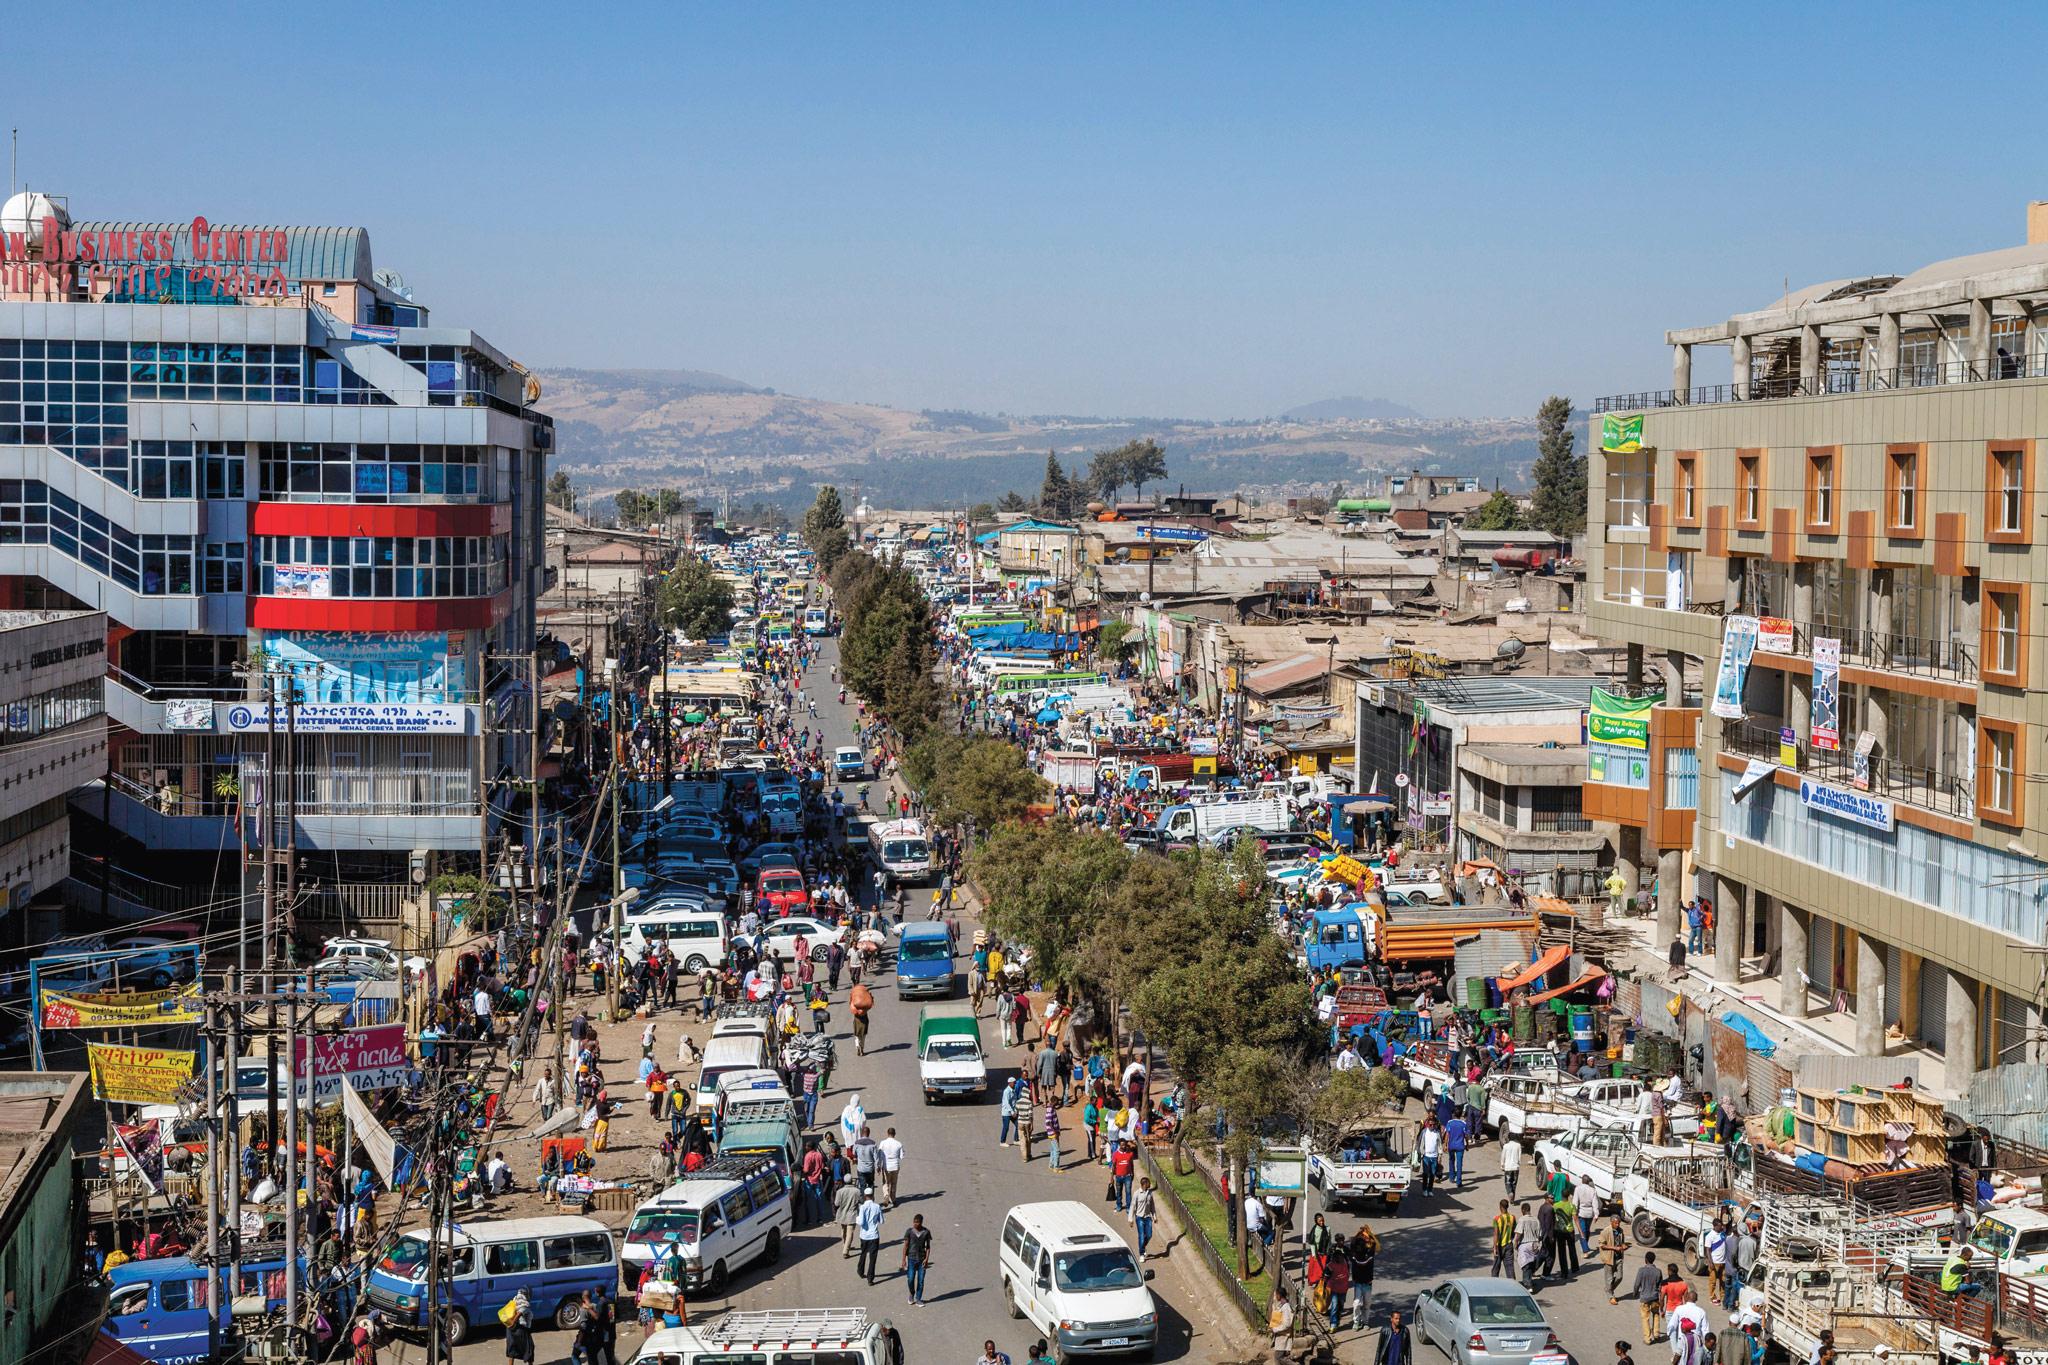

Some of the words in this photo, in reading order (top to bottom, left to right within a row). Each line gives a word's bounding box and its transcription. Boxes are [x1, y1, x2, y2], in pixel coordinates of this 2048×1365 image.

[297, 717, 393, 725] INTERNATIONAL
[358, 1046, 402, 1067] በርበሬ
[1349, 1171, 1396, 1180] TOYOTA
